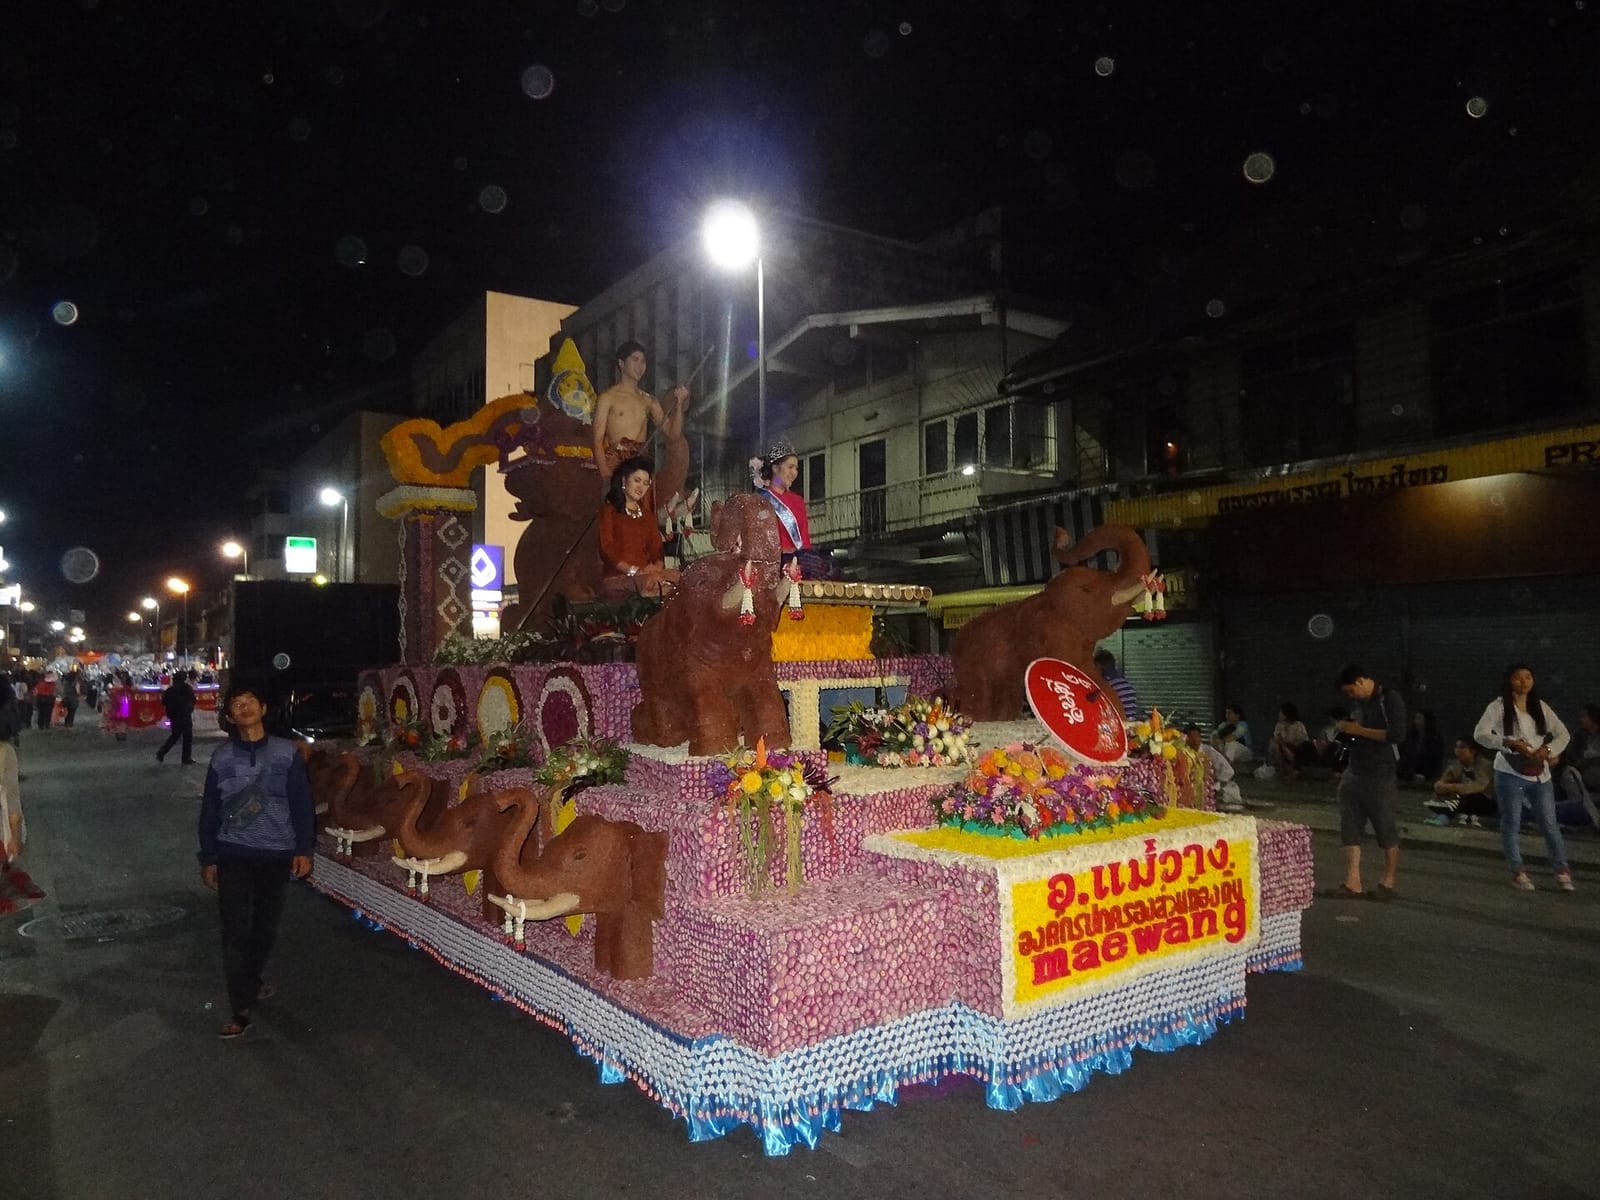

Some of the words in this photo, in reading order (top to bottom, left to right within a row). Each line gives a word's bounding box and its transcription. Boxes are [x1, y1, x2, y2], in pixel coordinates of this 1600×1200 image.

[1047, 838, 1229, 910] อ.แม่วาง
[1031, 900, 1247, 986] maewang
